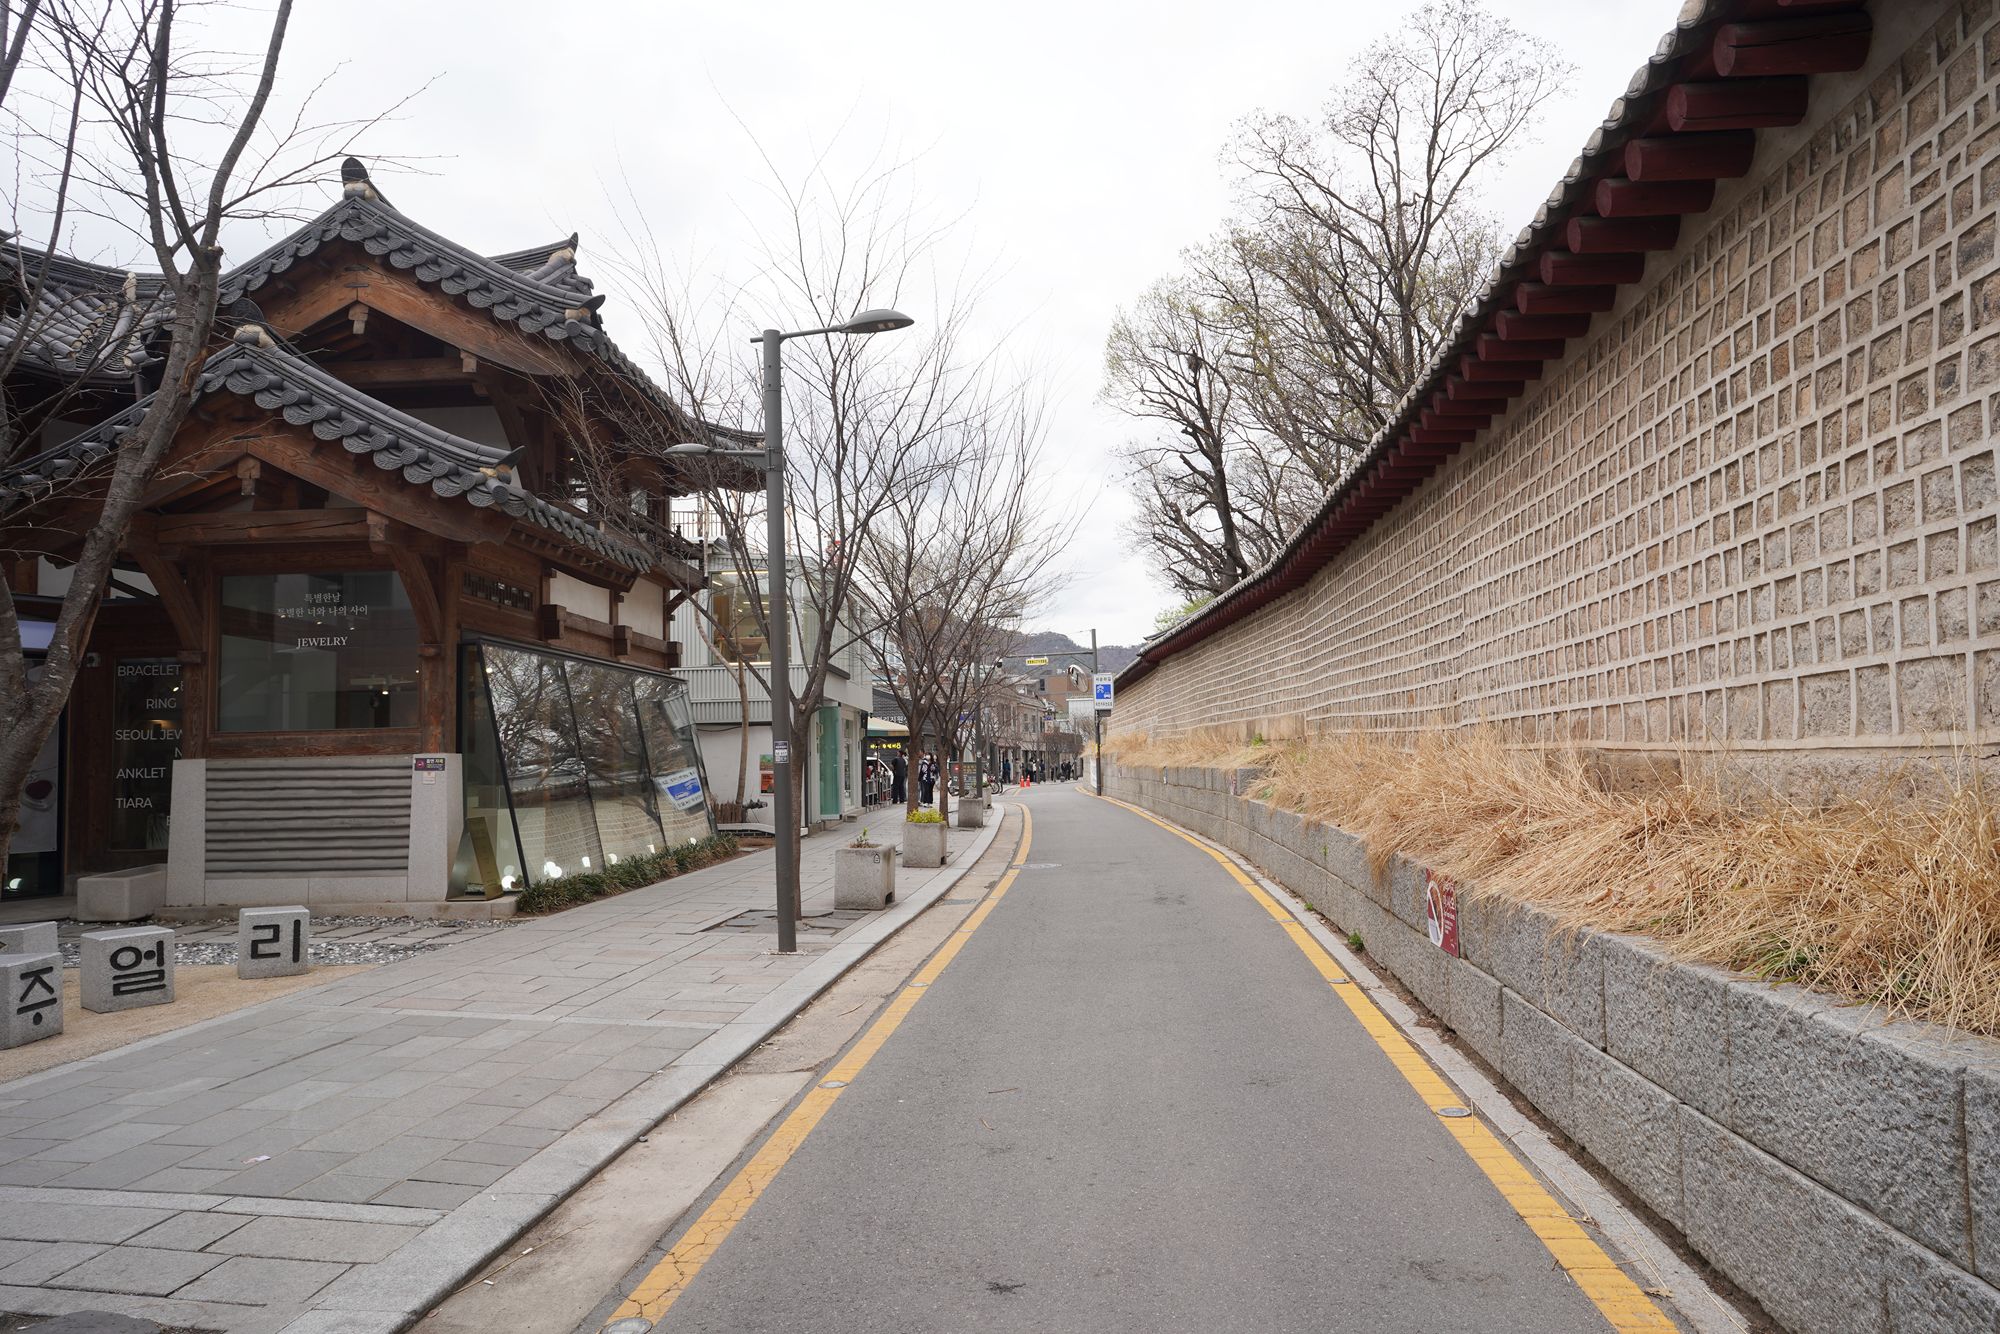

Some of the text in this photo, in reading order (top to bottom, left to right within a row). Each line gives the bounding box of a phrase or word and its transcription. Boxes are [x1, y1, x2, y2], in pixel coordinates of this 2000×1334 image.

[304, 593, 341, 603] 특별한날
[308, 607, 325, 617] 너와
[329, 606, 347, 616] 나의
[351, 605, 368, 615] 사이
[296, 637, 348, 649] JEWELRY
[117, 665, 181, 677] BRACELET
[146, 698, 177, 709] RING
[115, 729, 157, 740] SEOUL
[116, 767, 166, 779] ANKLET
[115, 797, 153, 809] TIARA
[109, 940, 167, 996] 얼
[250, 919, 301, 963] 리
